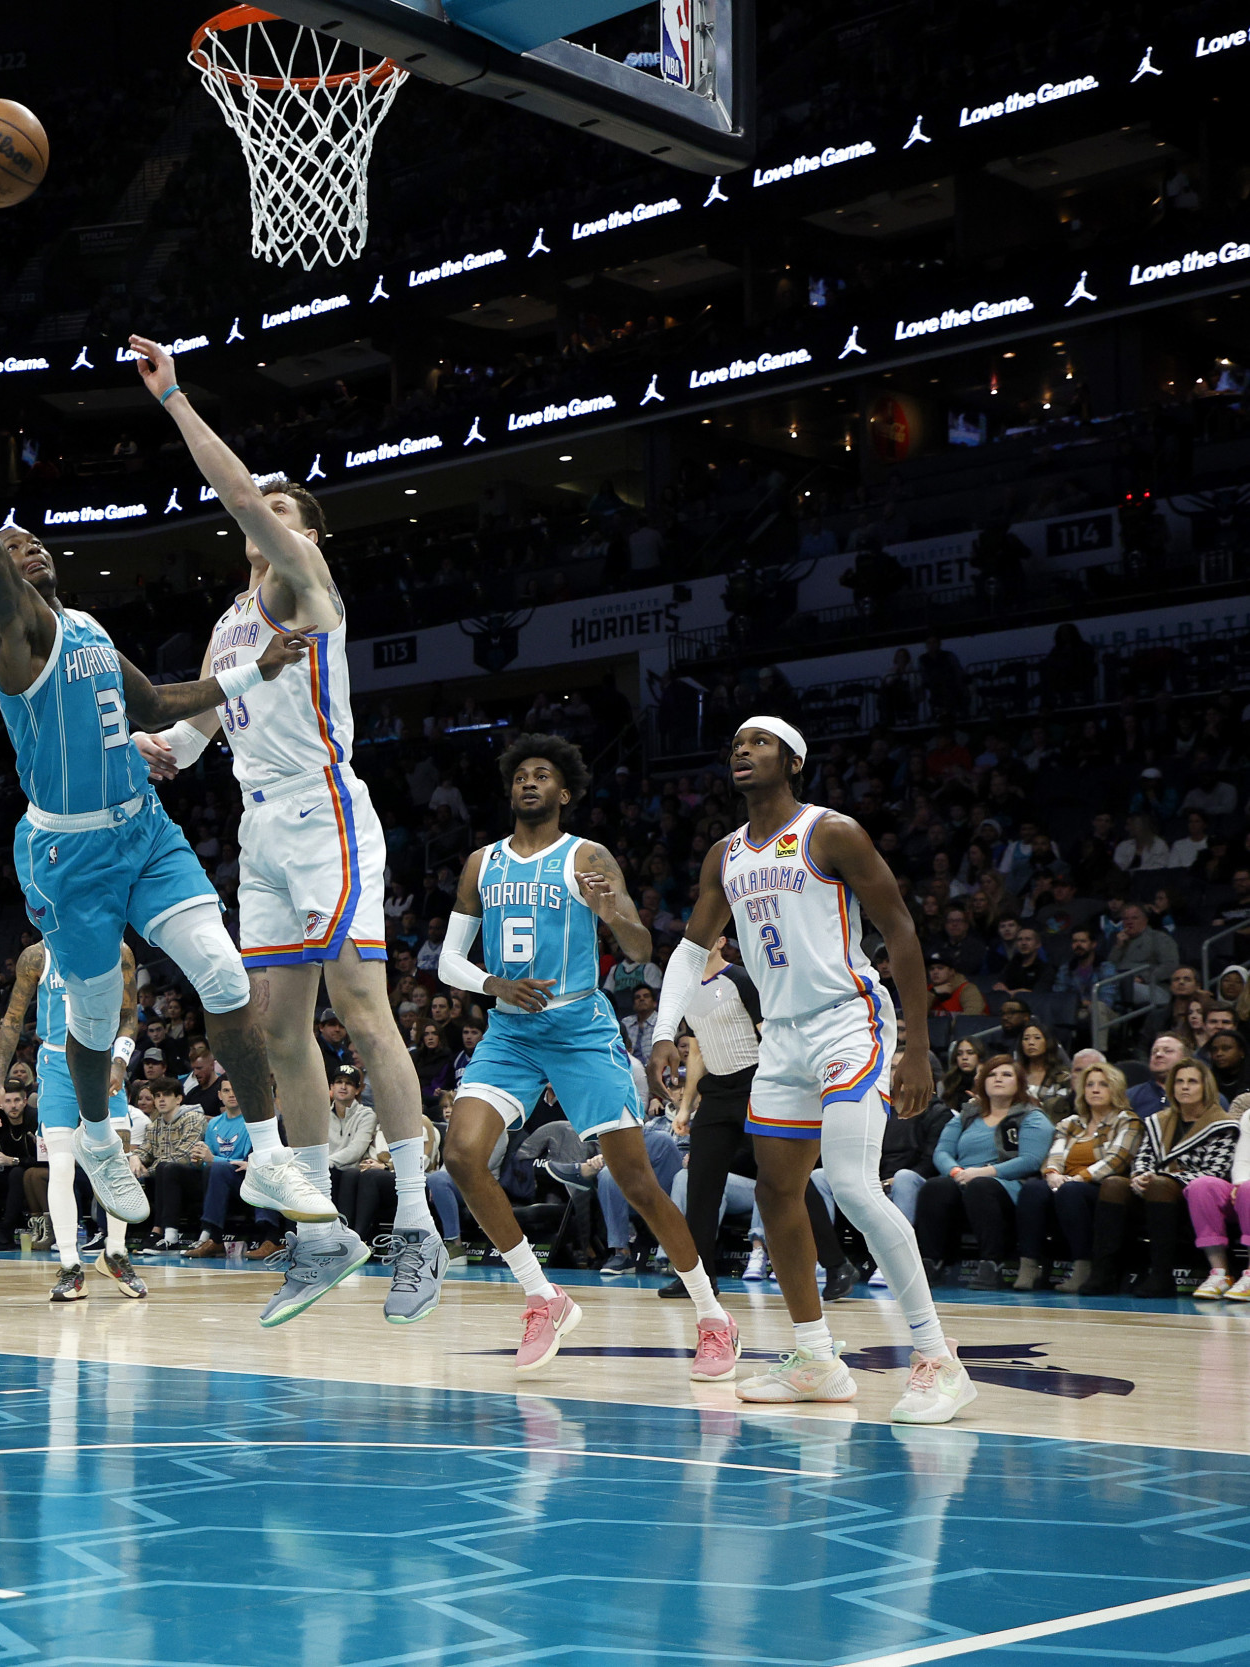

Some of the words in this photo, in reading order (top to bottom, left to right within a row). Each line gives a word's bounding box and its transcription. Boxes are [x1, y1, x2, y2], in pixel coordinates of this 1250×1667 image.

[1196, 30, 1247, 57] Love
[664, 55, 680, 79] NBA
[960, 102, 1004, 126] Love
[1005, 93, 1036, 113] the
[1036, 76, 1098, 103] Game.
[753, 164, 793, 186] Love
[793, 156, 820, 175] the
[820, 141, 876, 166] Game.
[573, 219, 607, 239] Love
[608, 211, 632, 229] the
[632, 199, 681, 221] Game.
[409, 268, 440, 286] Love
[440, 260, 462, 277] the
[462, 249, 506, 270] Game.
[1130, 261, 1181, 285] Love
[1182, 251, 1218, 272] the
[262, 311, 290, 329] Love
[290, 305, 310, 320] the
[310, 295, 350, 314] Game.
[895, 318, 939, 340] Love
[939, 309, 971, 329] the
[971, 297, 1033, 321] Game.
[173, 335, 209, 354] Game.
[4, 357, 49, 372] Game.
[690, 368, 729, 388] Love
[729, 360, 757, 379] the
[757, 349, 811, 372] Game.
[508, 412, 543, 430] Love
[543, 404, 568, 422] the
[568, 396, 616, 416] Game.
[346, 450, 377, 467] Love
[378, 443, 400, 460] the
[400, 436, 442, 454] Game.
[45, 510, 80, 524] Love
[80, 507, 104, 521] the
[104, 504, 147, 519] Game.
[1058, 522, 1100, 551] 114
[571, 602, 681, 649] HORNETS
[381, 642, 409, 663] 113
[95, 687, 130, 751] 3
[220, 696, 250, 735] 33
[481, 881, 563, 911] HORNETS
[745, 894, 781, 923] CITY
[502, 916, 534, 963] 6
[759, 923, 789, 969] 2
[1130, 1273, 1139, 1284] 7
